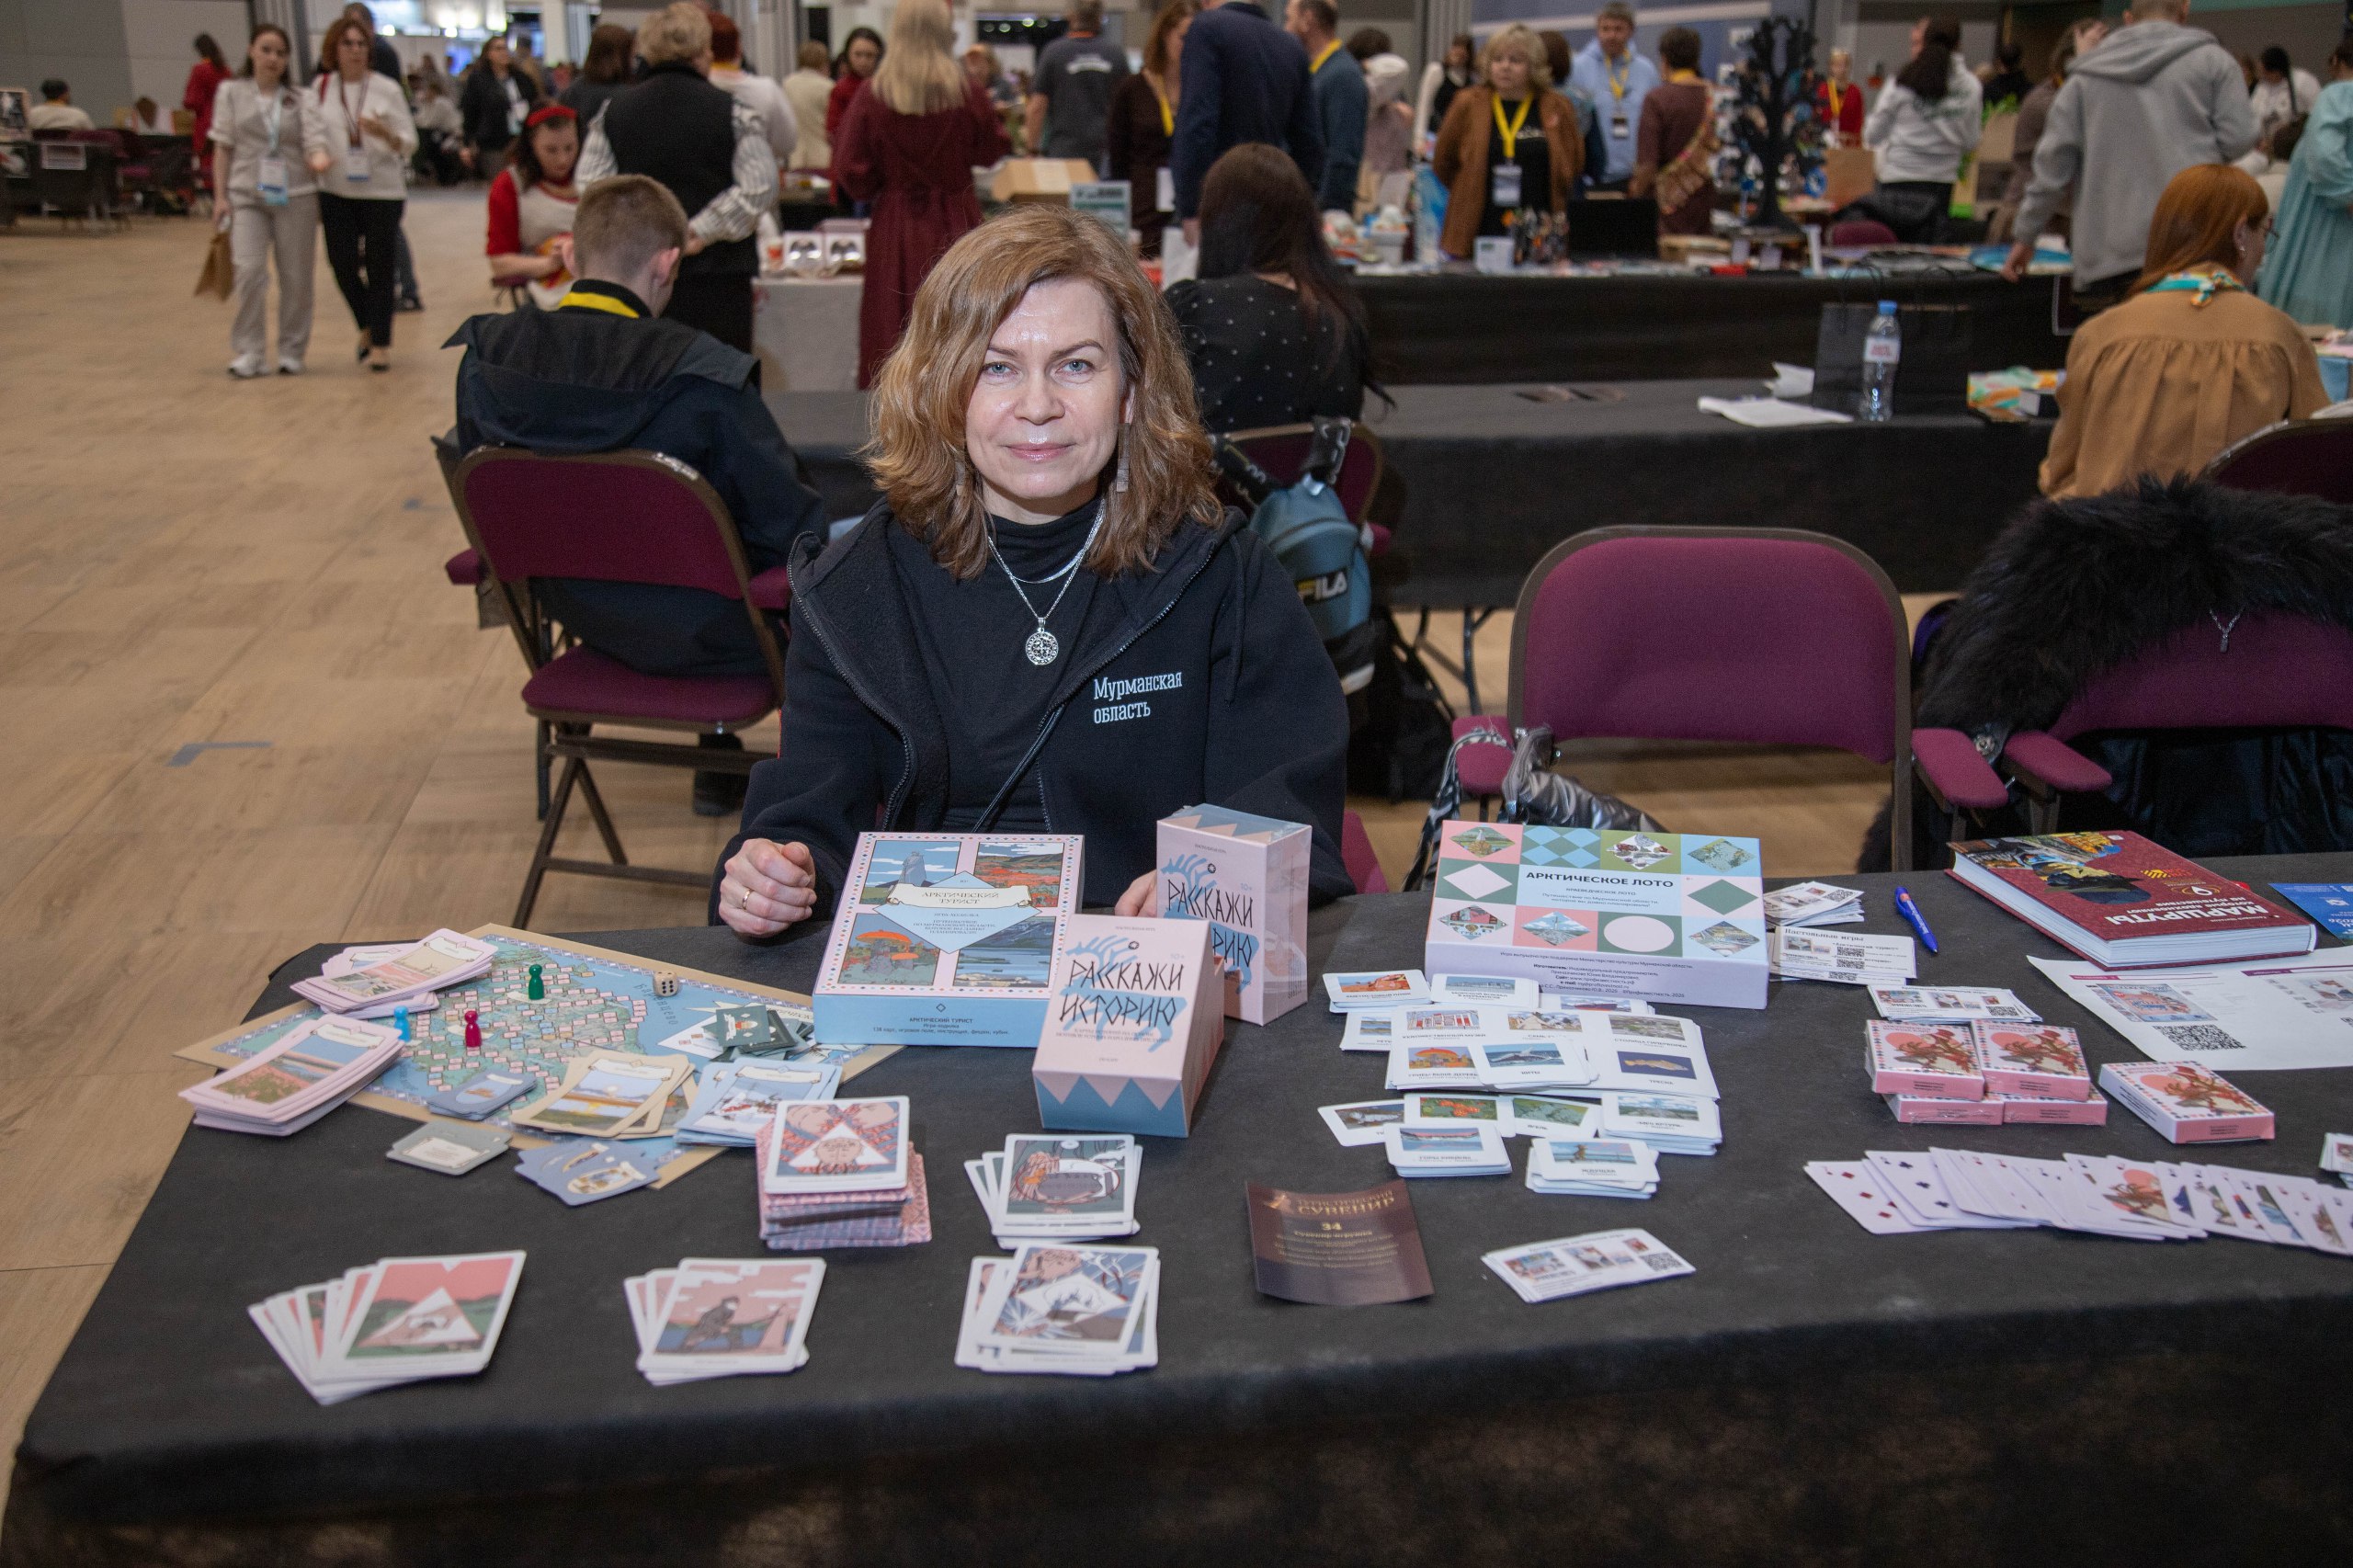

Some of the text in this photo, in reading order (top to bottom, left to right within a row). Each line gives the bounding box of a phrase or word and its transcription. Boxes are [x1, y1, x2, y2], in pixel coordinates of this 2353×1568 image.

[1298, 572, 1347, 597] FILA
[1094, 672, 1183, 701] Мурманская
[1094, 701, 1151, 724] область
[1526, 872, 1674, 888] АРКТИЧЕСКОЕ ЛОТО
[922, 891, 999, 899] АРКТИЧЕСКИЙ
[1167, 879, 1253, 928] РАССКАЖИ
[2104, 904, 2269, 926] МАРШРУТЫ
[1785, 928, 1838, 939] Настольные
[1068, 960, 1184, 991] РАССКАЖИ
[1059, 994, 1177, 1028] ИСТОРИЮ
